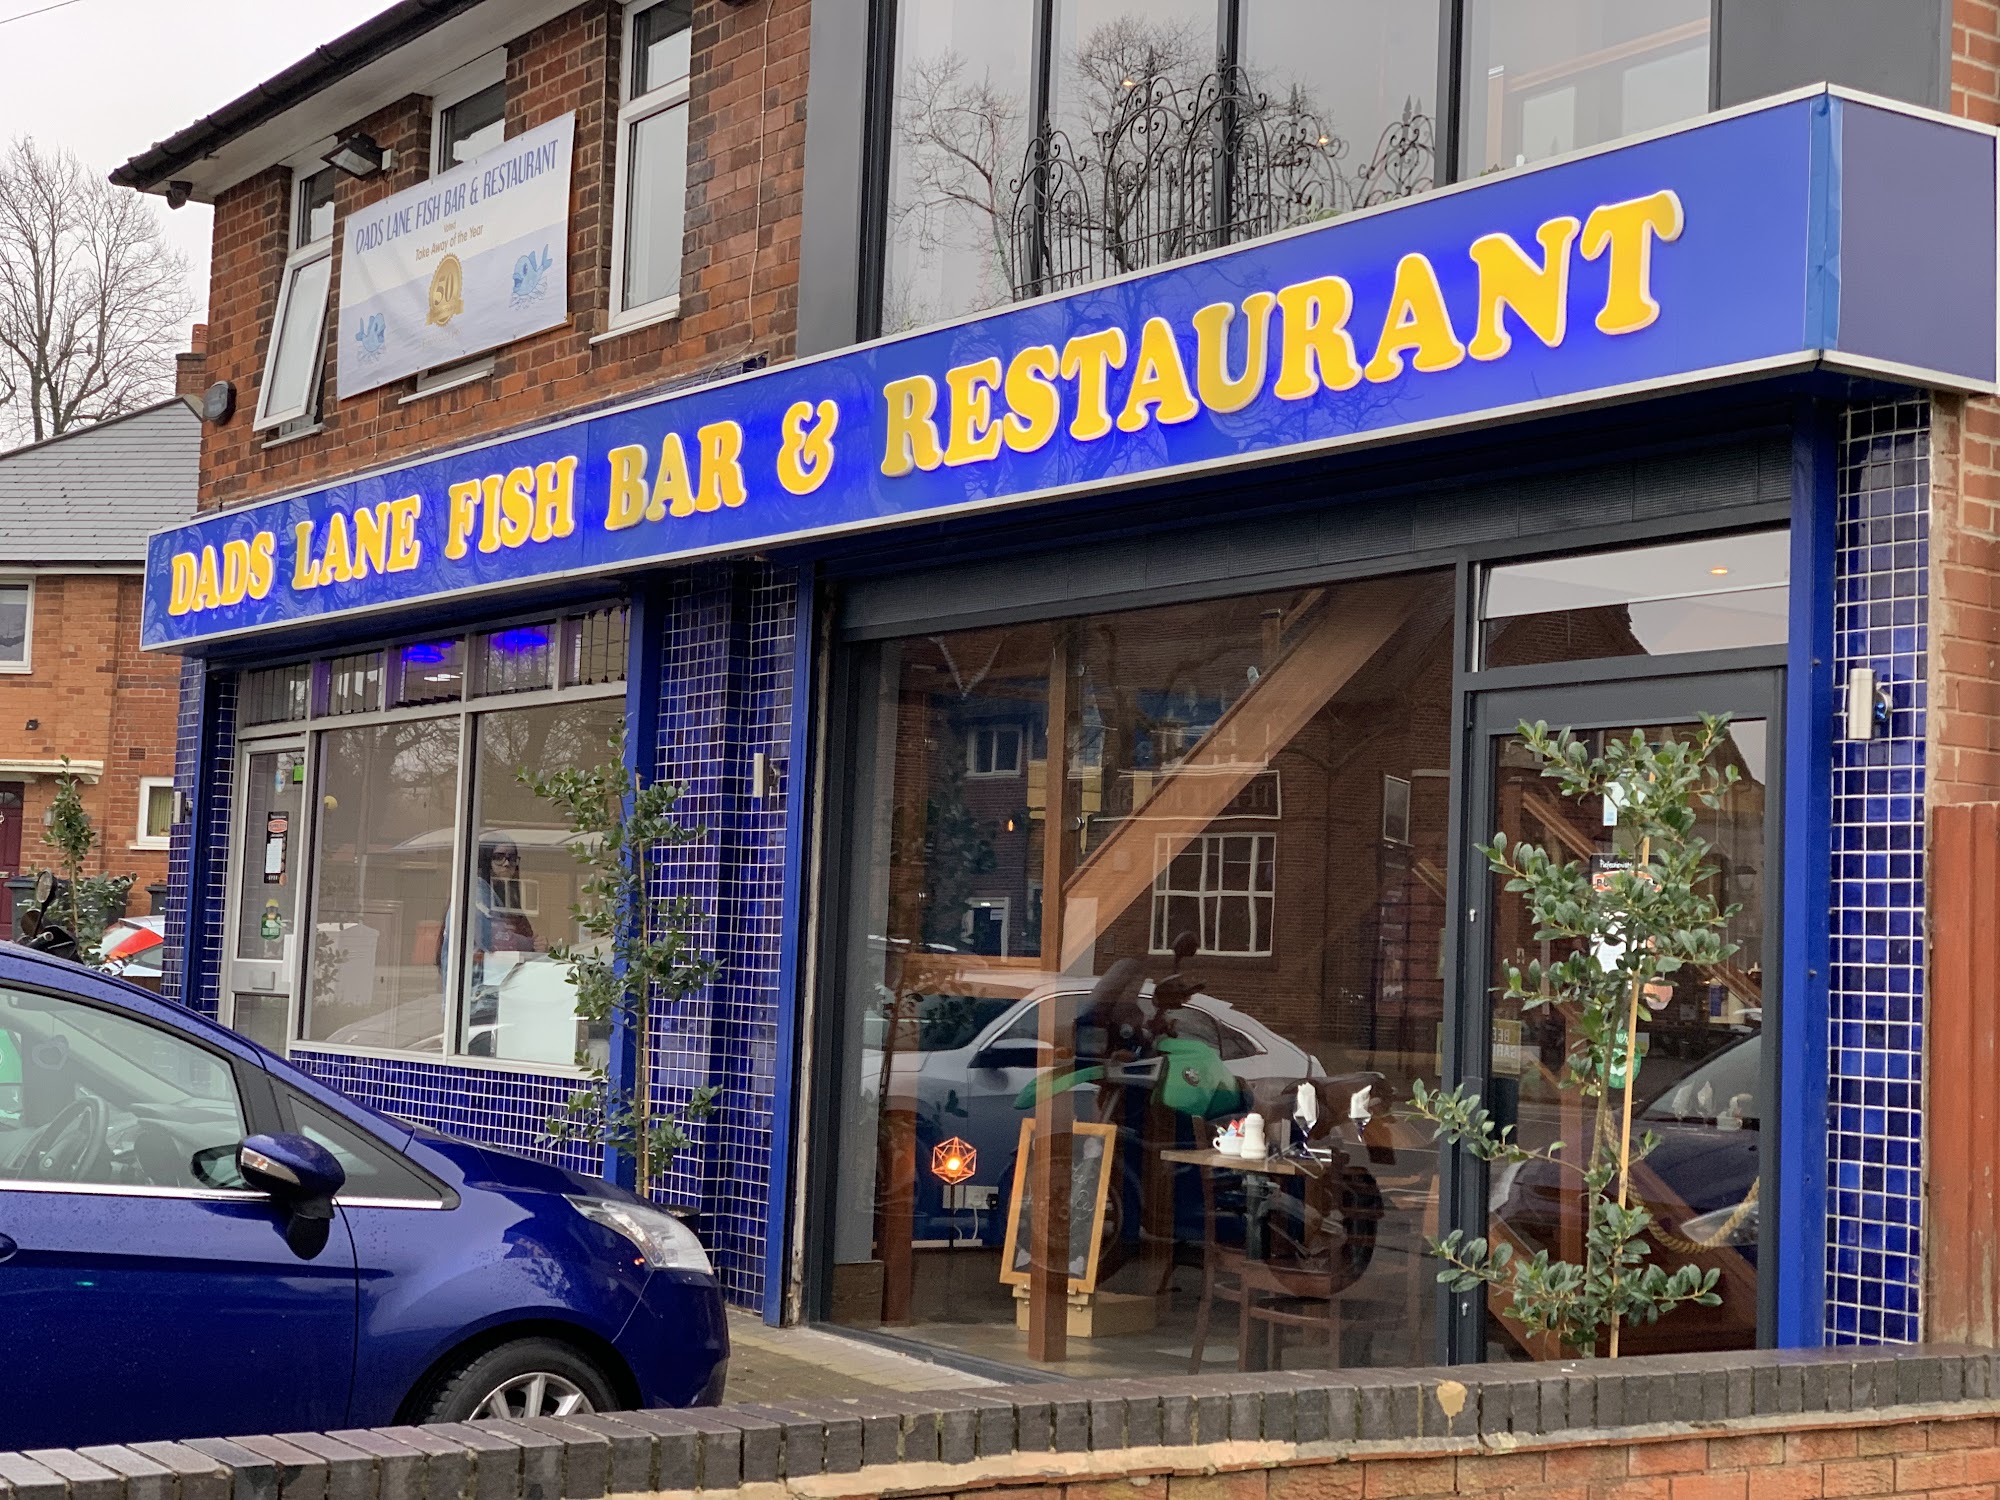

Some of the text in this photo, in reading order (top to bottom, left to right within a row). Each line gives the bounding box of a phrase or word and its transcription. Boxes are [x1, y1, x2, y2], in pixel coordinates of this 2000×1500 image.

[355, 139, 558, 254] DADS LANE FISH BAR & RESTAURANT
[415, 224, 484, 261] Take Away of the Year
[434, 272, 454, 306] 50
[168, 189, 1684, 617] DADS LANE FISH BAR & RESTAURANT
